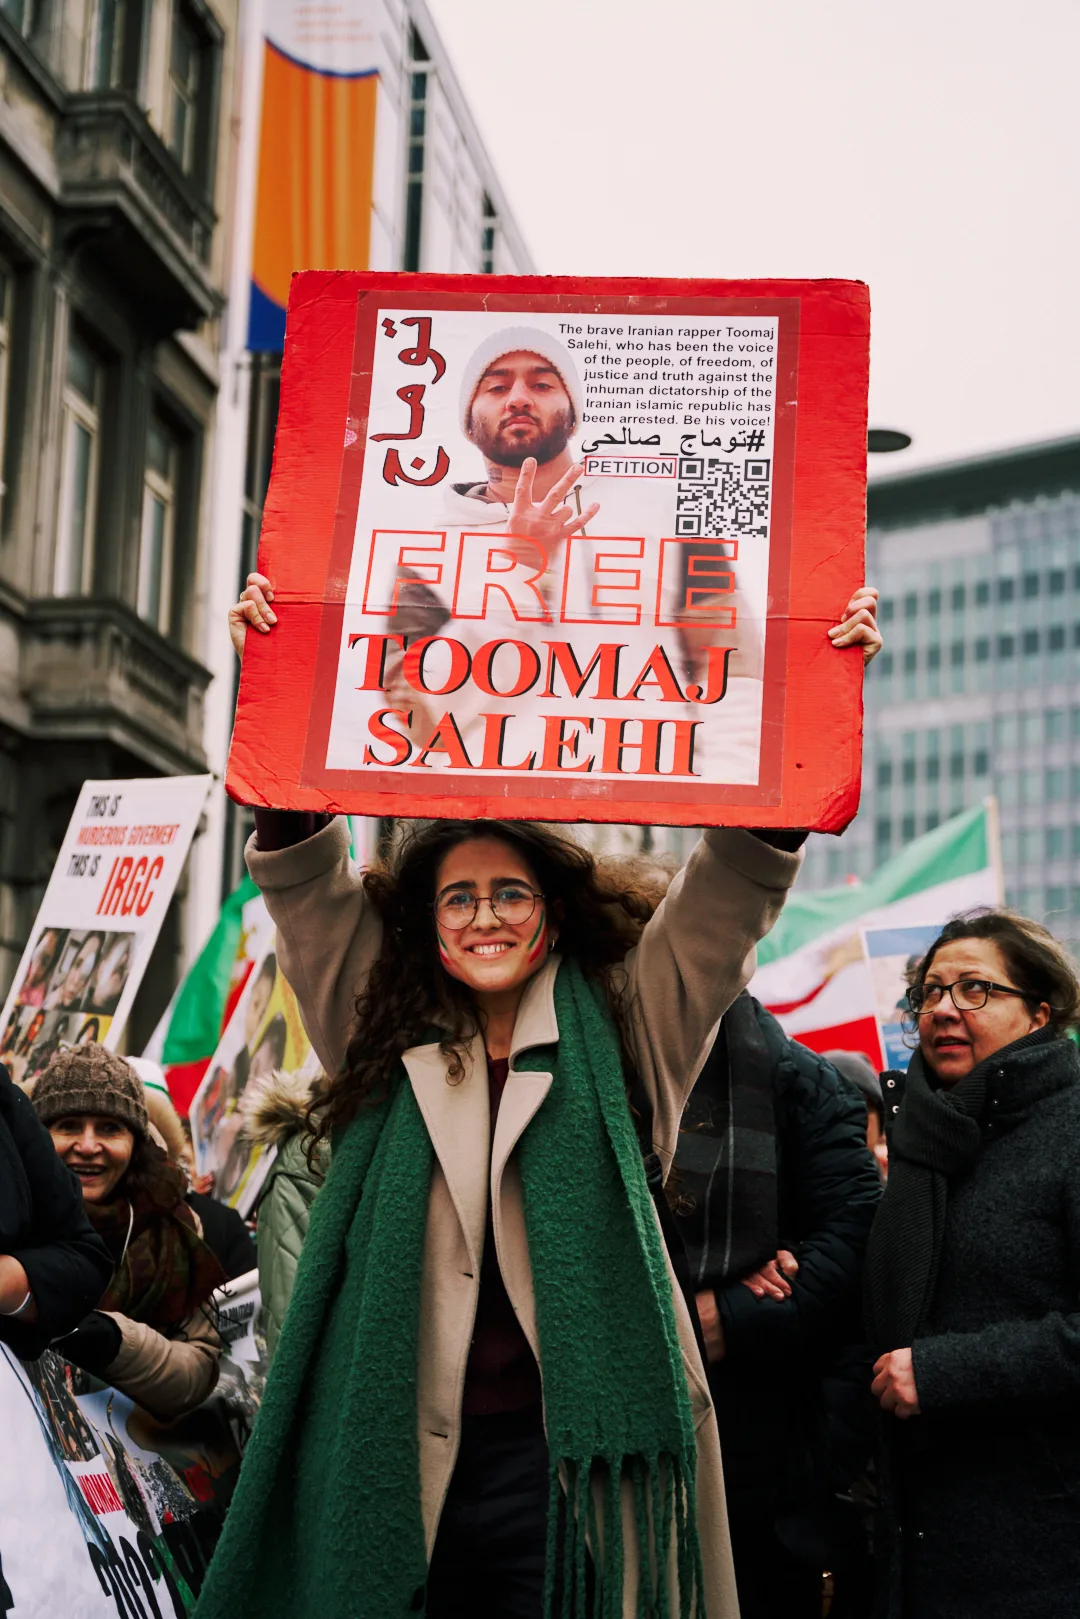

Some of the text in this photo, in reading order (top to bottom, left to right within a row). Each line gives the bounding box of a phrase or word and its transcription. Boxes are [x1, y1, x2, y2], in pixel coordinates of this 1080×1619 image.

[559, 323, 775, 341] The brave Iranian rapper Toomaj
[567, 339, 775, 354] Salehi, who has been the voice
[584, 355, 774, 369] of the people, of freedom, of
[584, 370, 774, 385] justice and truth against the
[586, 385, 773, 399] inhuman dictatorship of the
[586, 399, 772, 413] Iranian islamic republic has
[582, 413, 771, 427] been arrested. Be his voice!
[588, 460, 673, 474] PETITION
[362, 529, 739, 629] FREE
[348, 633, 738, 704] TOOMAJ
[363, 707, 704, 777] SALEHI
[87, 795, 122, 817] THIS IS
[77, 826, 128, 846] MURDEROUS
[66, 855, 165, 917] THIS IS IRGC
